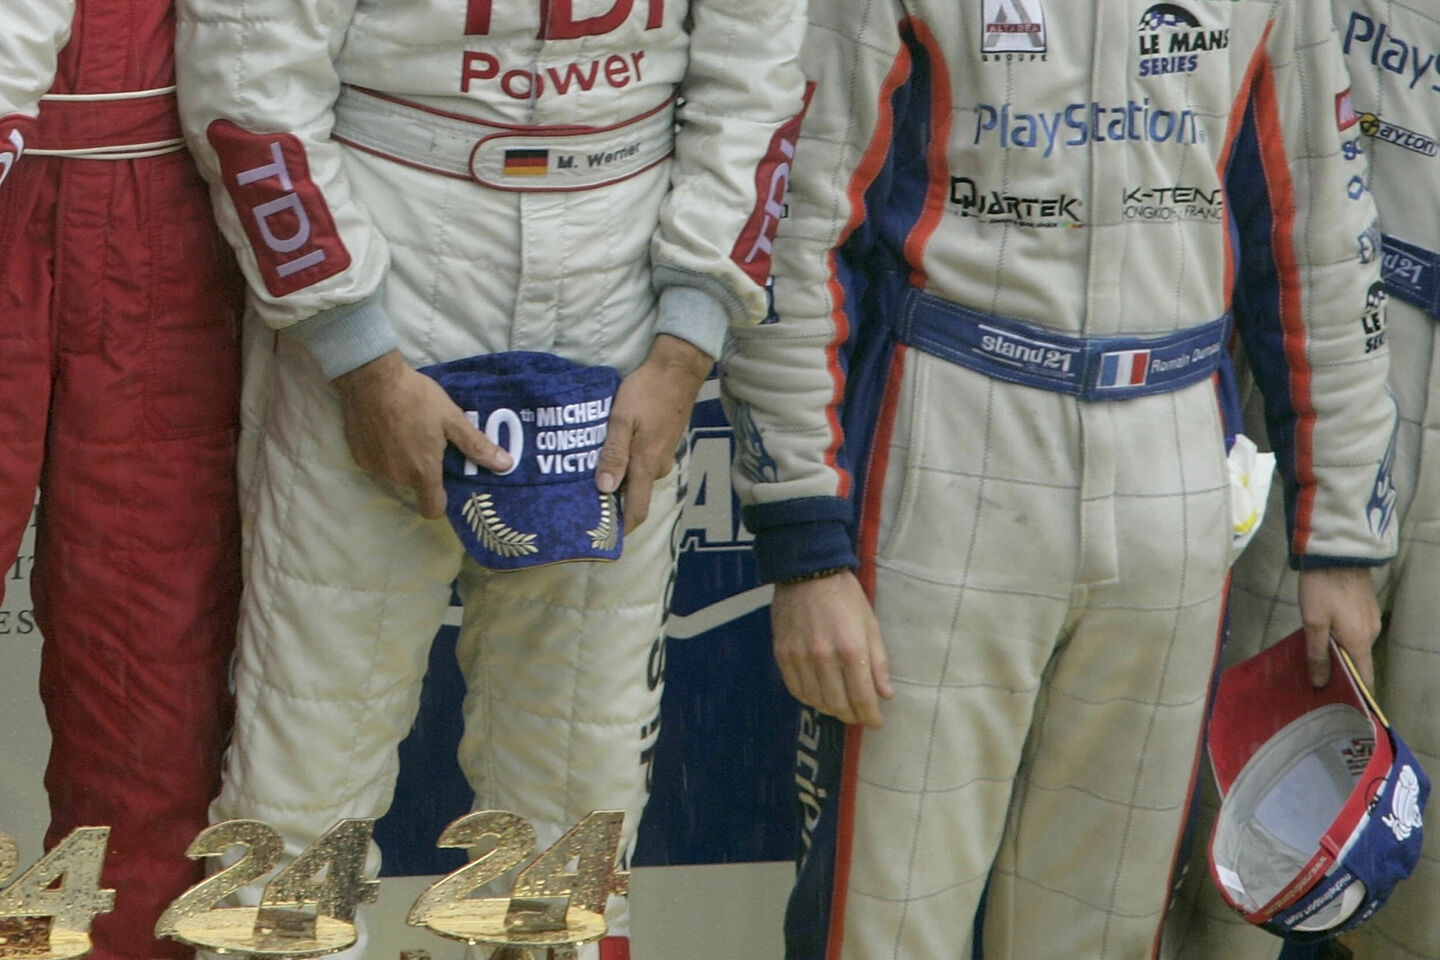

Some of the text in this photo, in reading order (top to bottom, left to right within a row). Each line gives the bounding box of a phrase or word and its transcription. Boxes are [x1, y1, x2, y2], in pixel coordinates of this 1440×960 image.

[1139, 28, 1229, 55] LE MANS
[1139, 55, 1199, 77] SERIES
[460, 49, 646, 100] Power
[974, 97, 1199, 157] PlayStation
[587, 141, 642, 169] Werner
[236, 142, 326, 278] TDI
[154, 817, 381, 939] 24
[406, 809, 632, 927] 24
